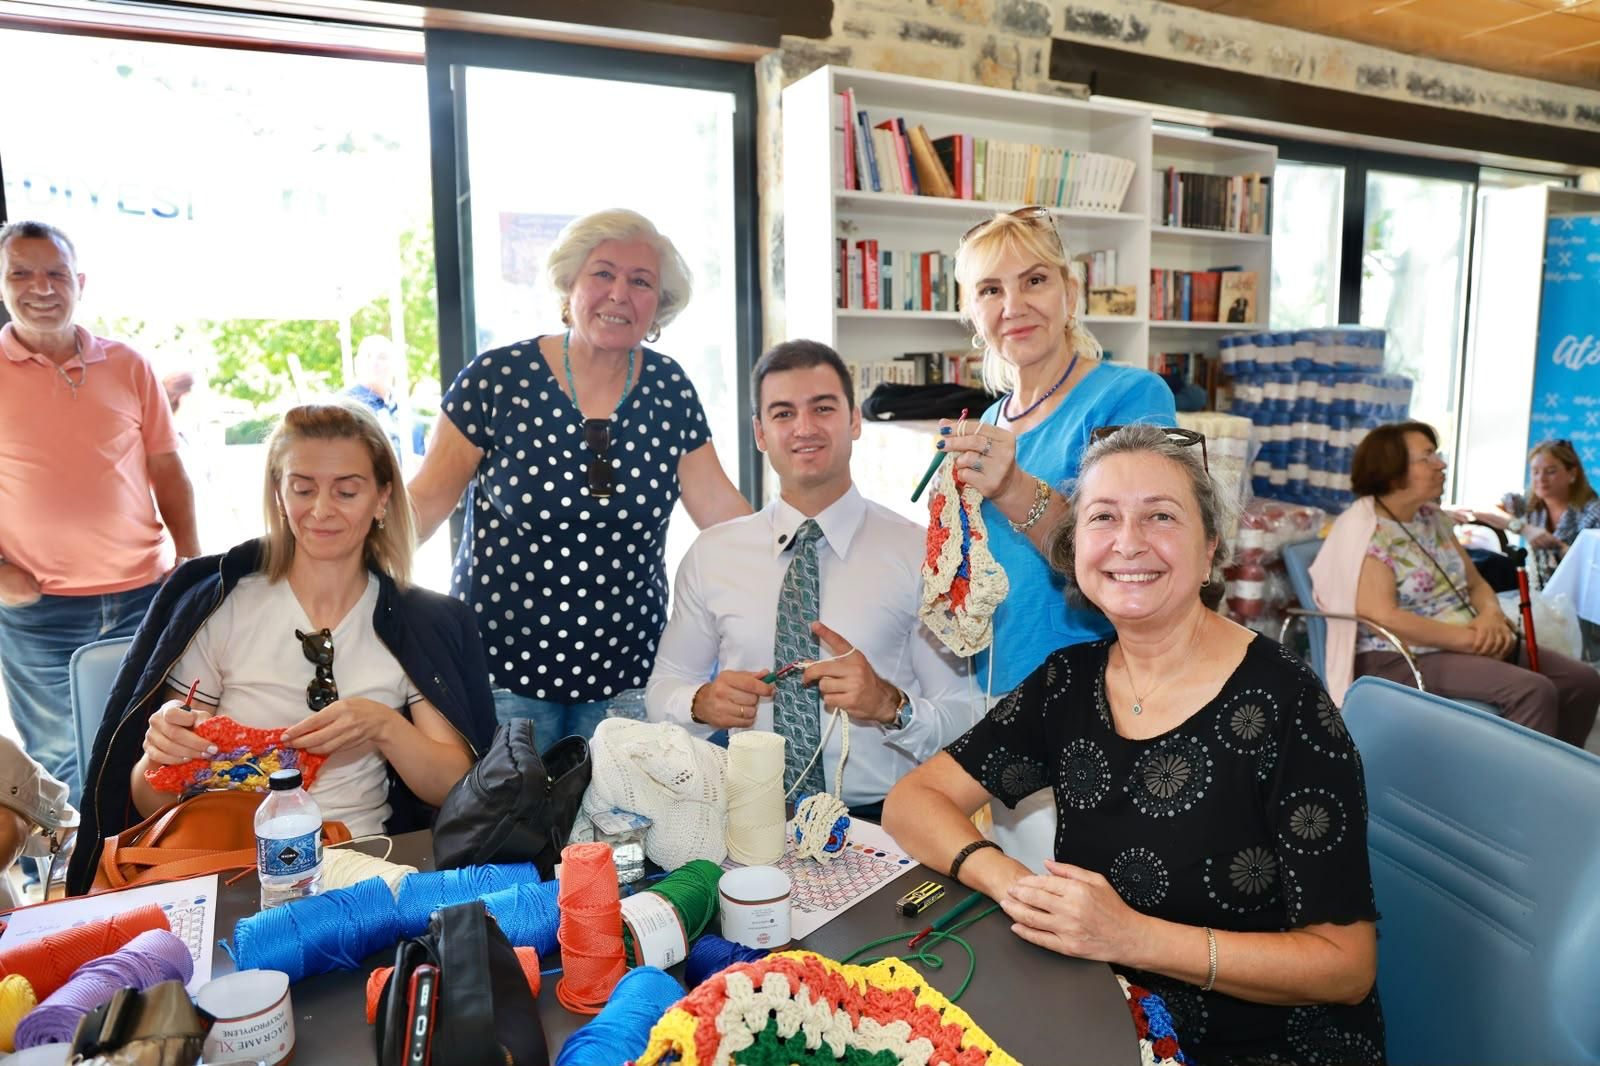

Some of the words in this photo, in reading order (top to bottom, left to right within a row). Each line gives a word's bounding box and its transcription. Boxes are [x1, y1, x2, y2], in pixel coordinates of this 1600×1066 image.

[223, 1010, 284, 1038] POLYPROPYLENE
[238, 1020, 288, 1050] MACRAME
[216, 1040, 235, 1054] XL
